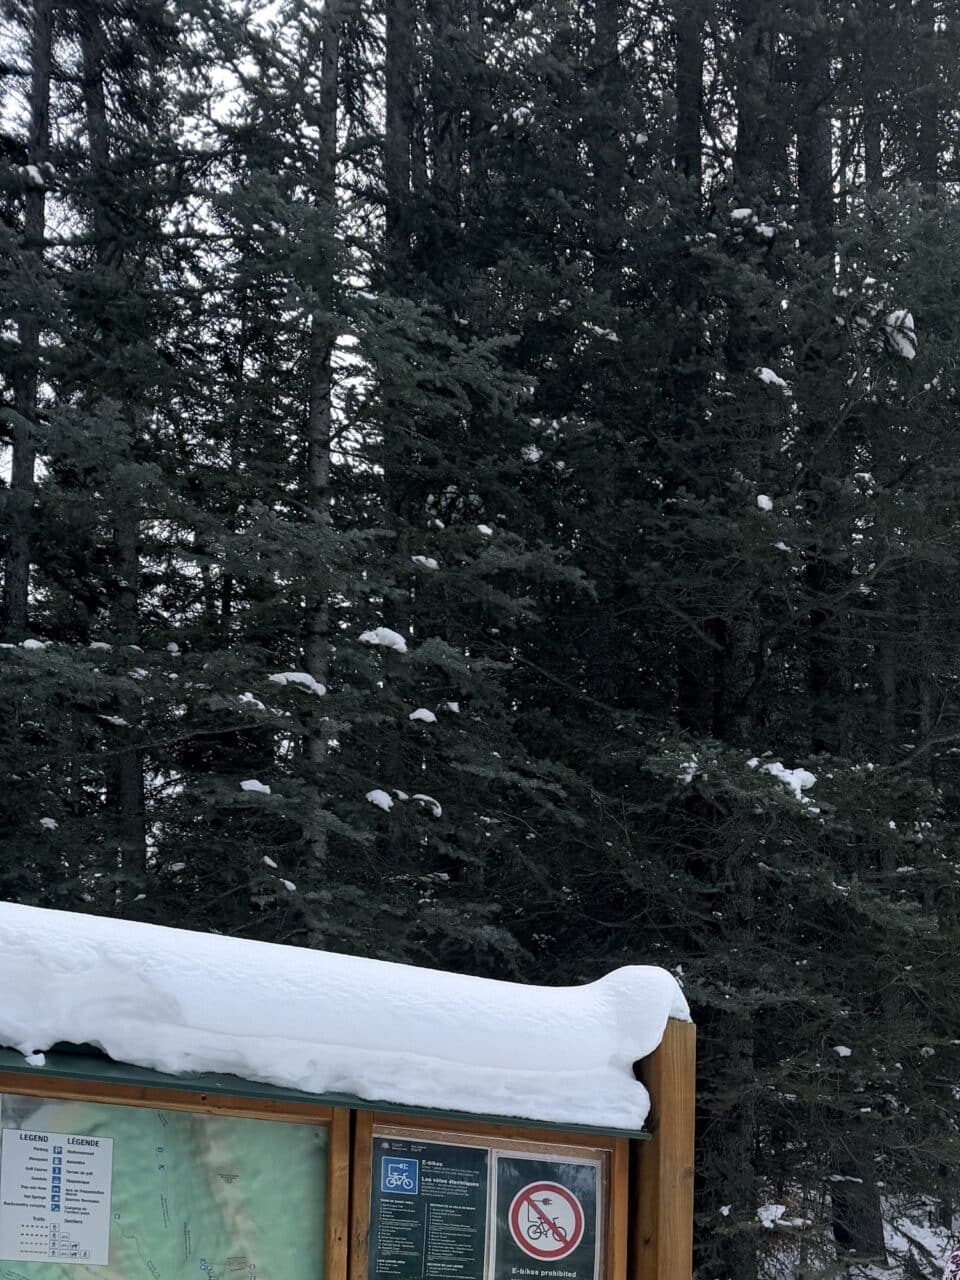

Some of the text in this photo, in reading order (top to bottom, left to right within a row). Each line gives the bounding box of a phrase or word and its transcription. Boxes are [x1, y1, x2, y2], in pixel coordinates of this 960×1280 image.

[20, 1133, 49, 1142] LEGEND
[67, 1137, 100, 1147] LÉGENDE
[511, 1267, 577, 1278] E-bikes prohibited
